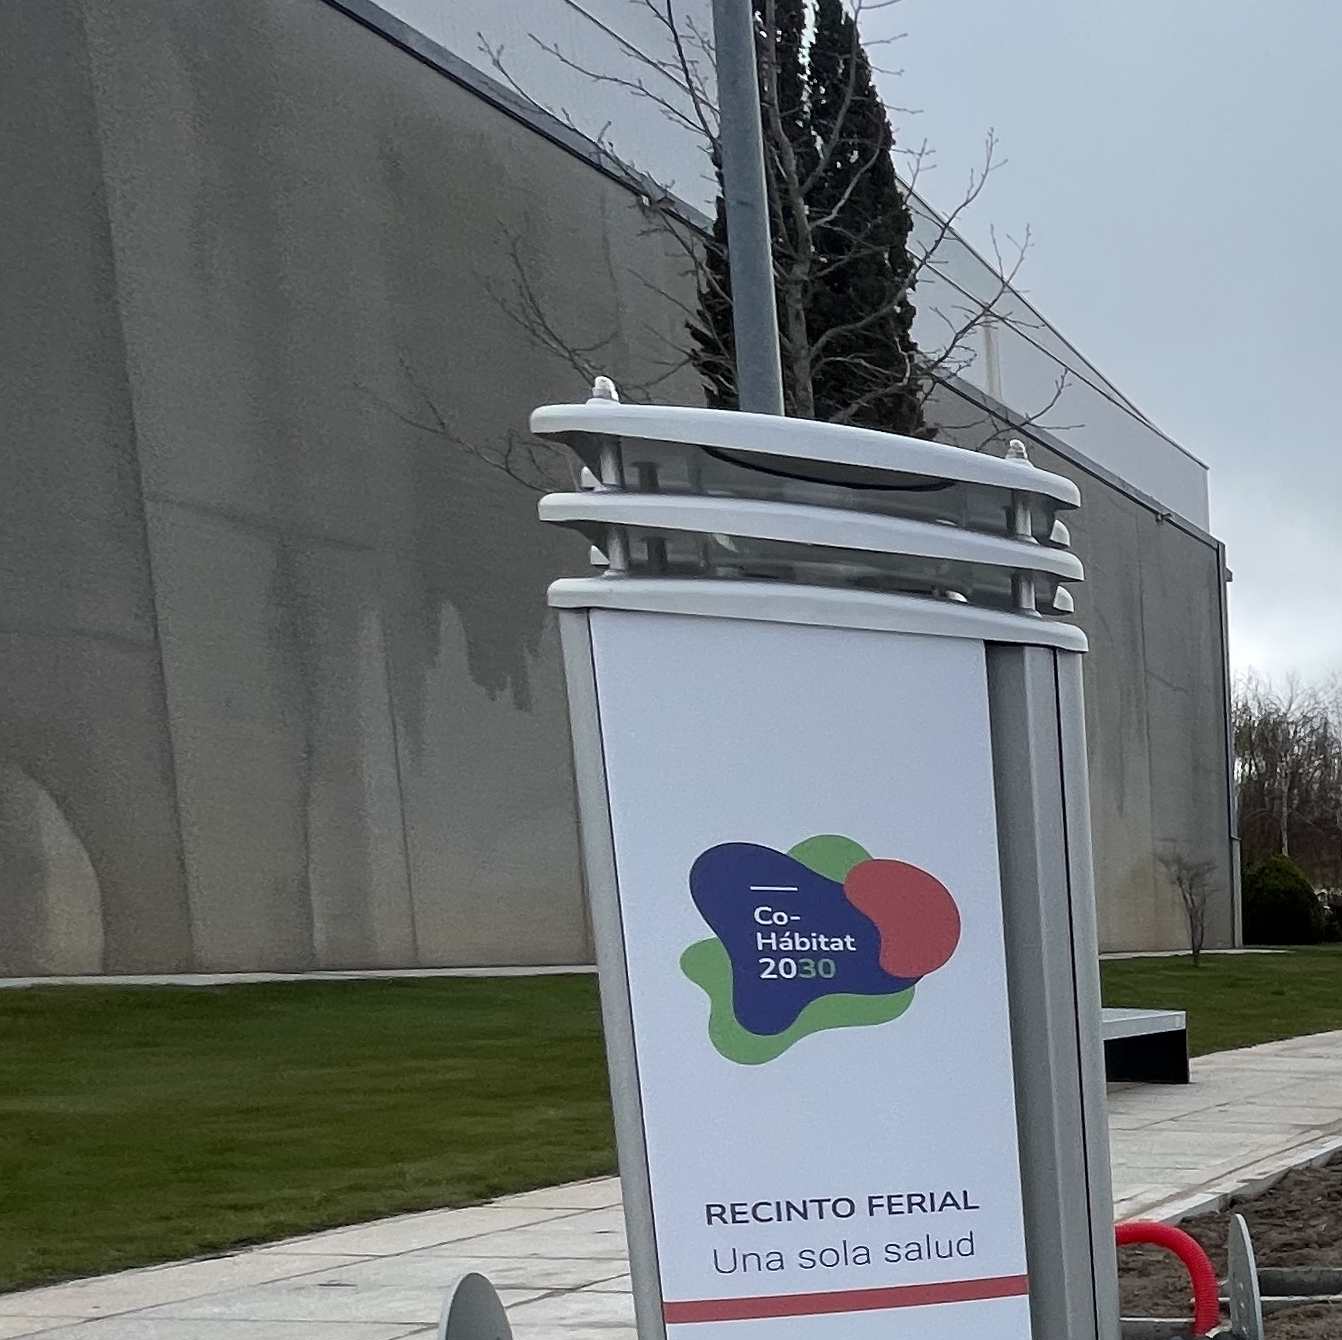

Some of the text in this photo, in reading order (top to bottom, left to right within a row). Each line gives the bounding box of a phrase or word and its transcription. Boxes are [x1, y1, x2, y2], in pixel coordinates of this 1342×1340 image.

[754, 905, 801, 926] Co-
[756, 932, 857, 953] Hábitat
[759, 957, 836, 979] 2030
[706, 1190, 979, 1225] RECINTO FERIAL
[713, 1230, 976, 1274] Una sola salud
